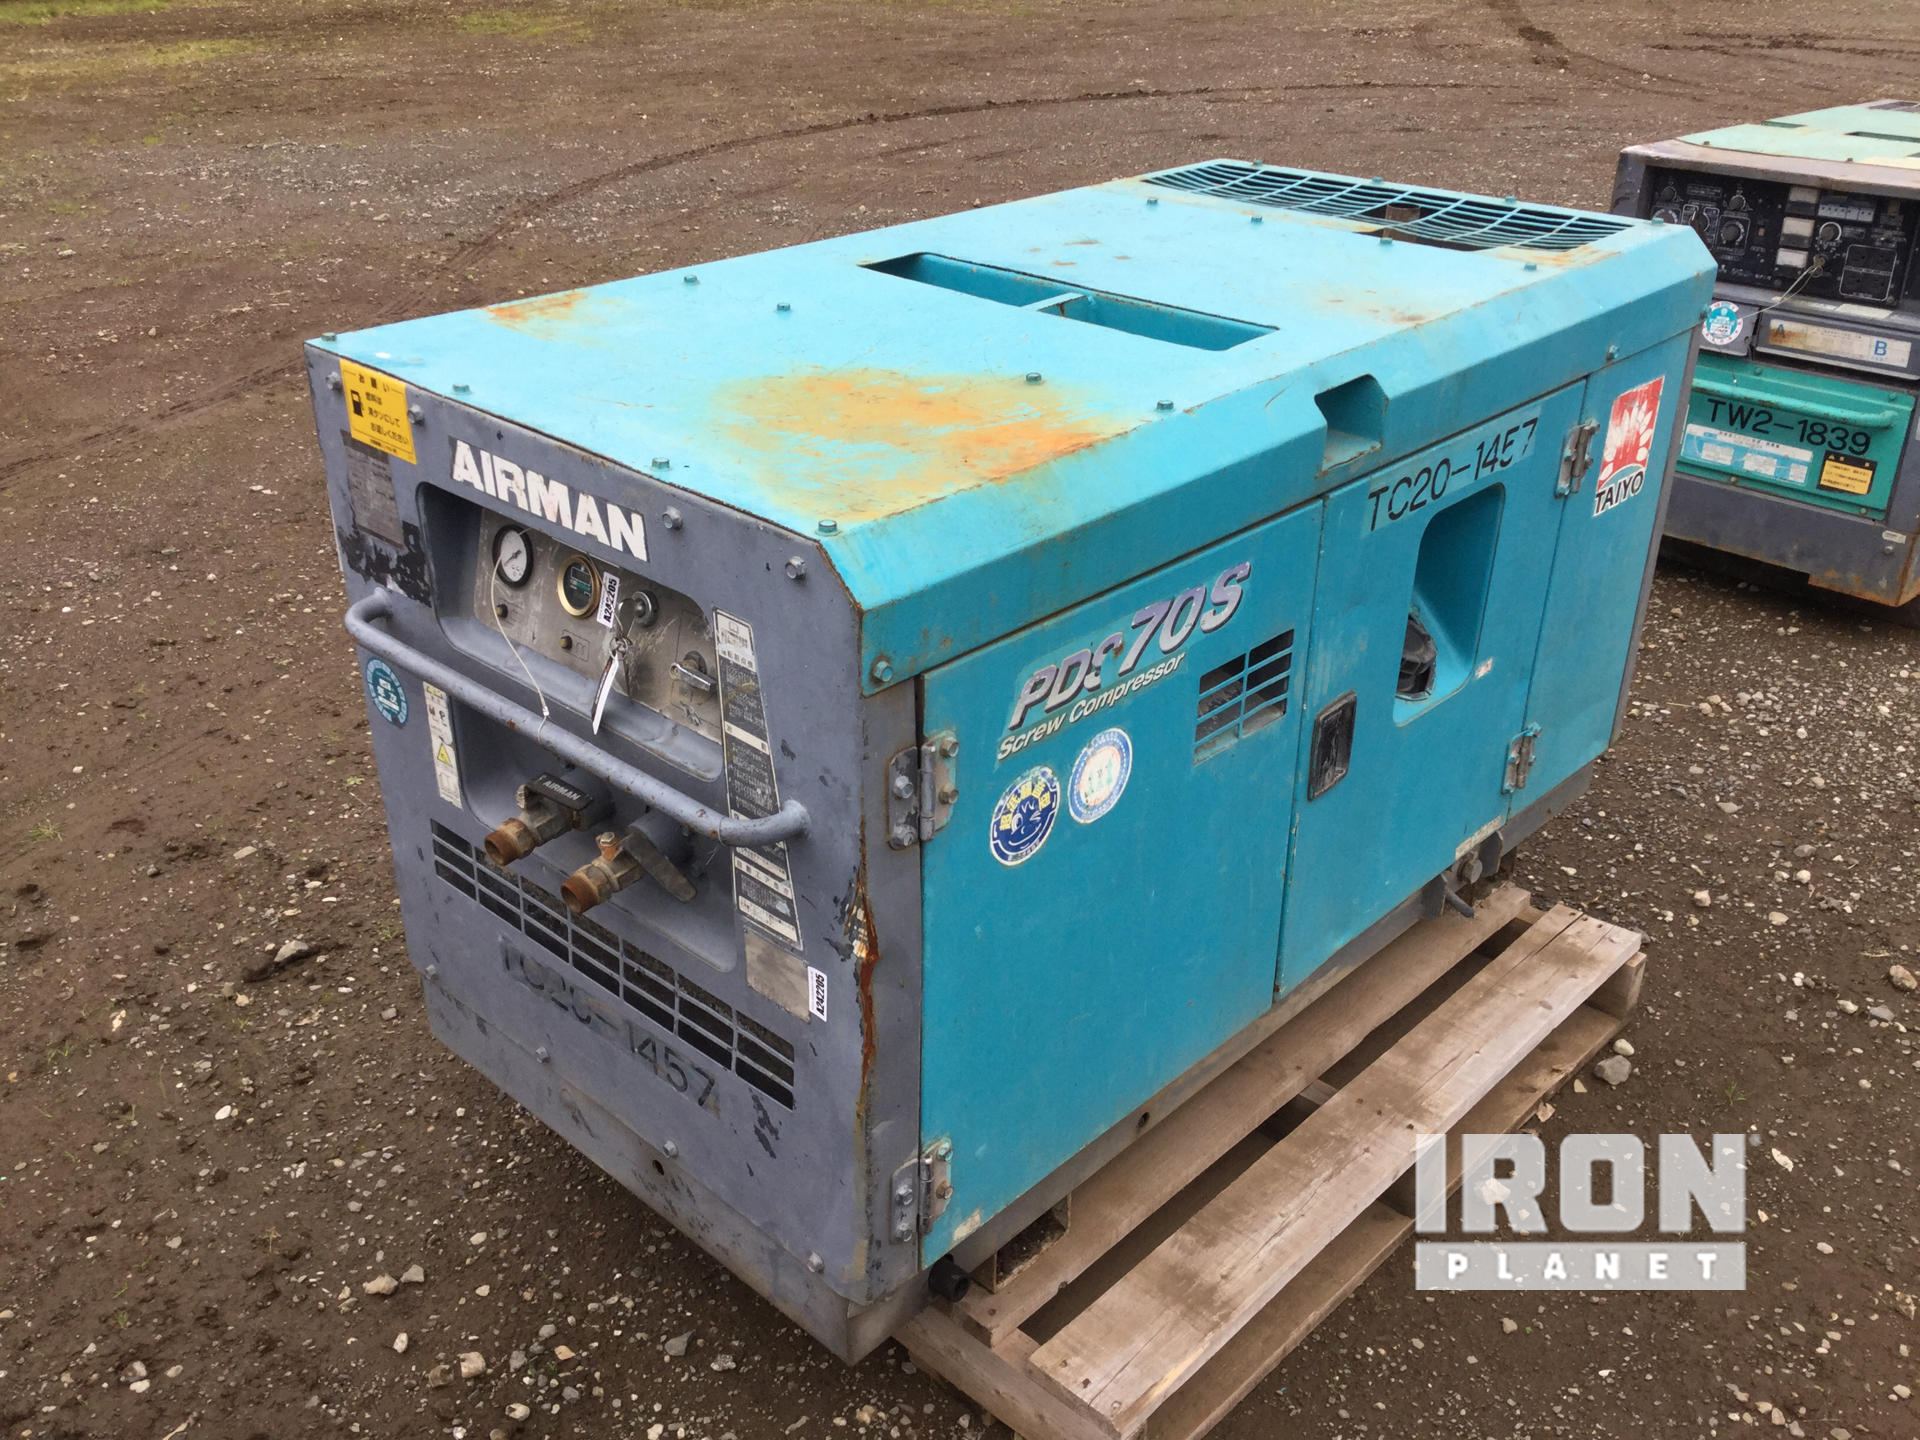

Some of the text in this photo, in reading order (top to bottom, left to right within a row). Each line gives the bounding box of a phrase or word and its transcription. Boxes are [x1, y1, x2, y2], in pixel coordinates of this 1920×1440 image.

[1874, 340, 1888, 356] B
[1707, 398, 1871, 455] TW2-1839
[453, 440, 648, 562] AIRMAN
[1595, 470, 1644, 513] TAIYO
[997, 653, 1186, 760] Screw Compressor
[543, 780, 581, 801] AIRMAN
[815, 972, 825, 1017] A242205
